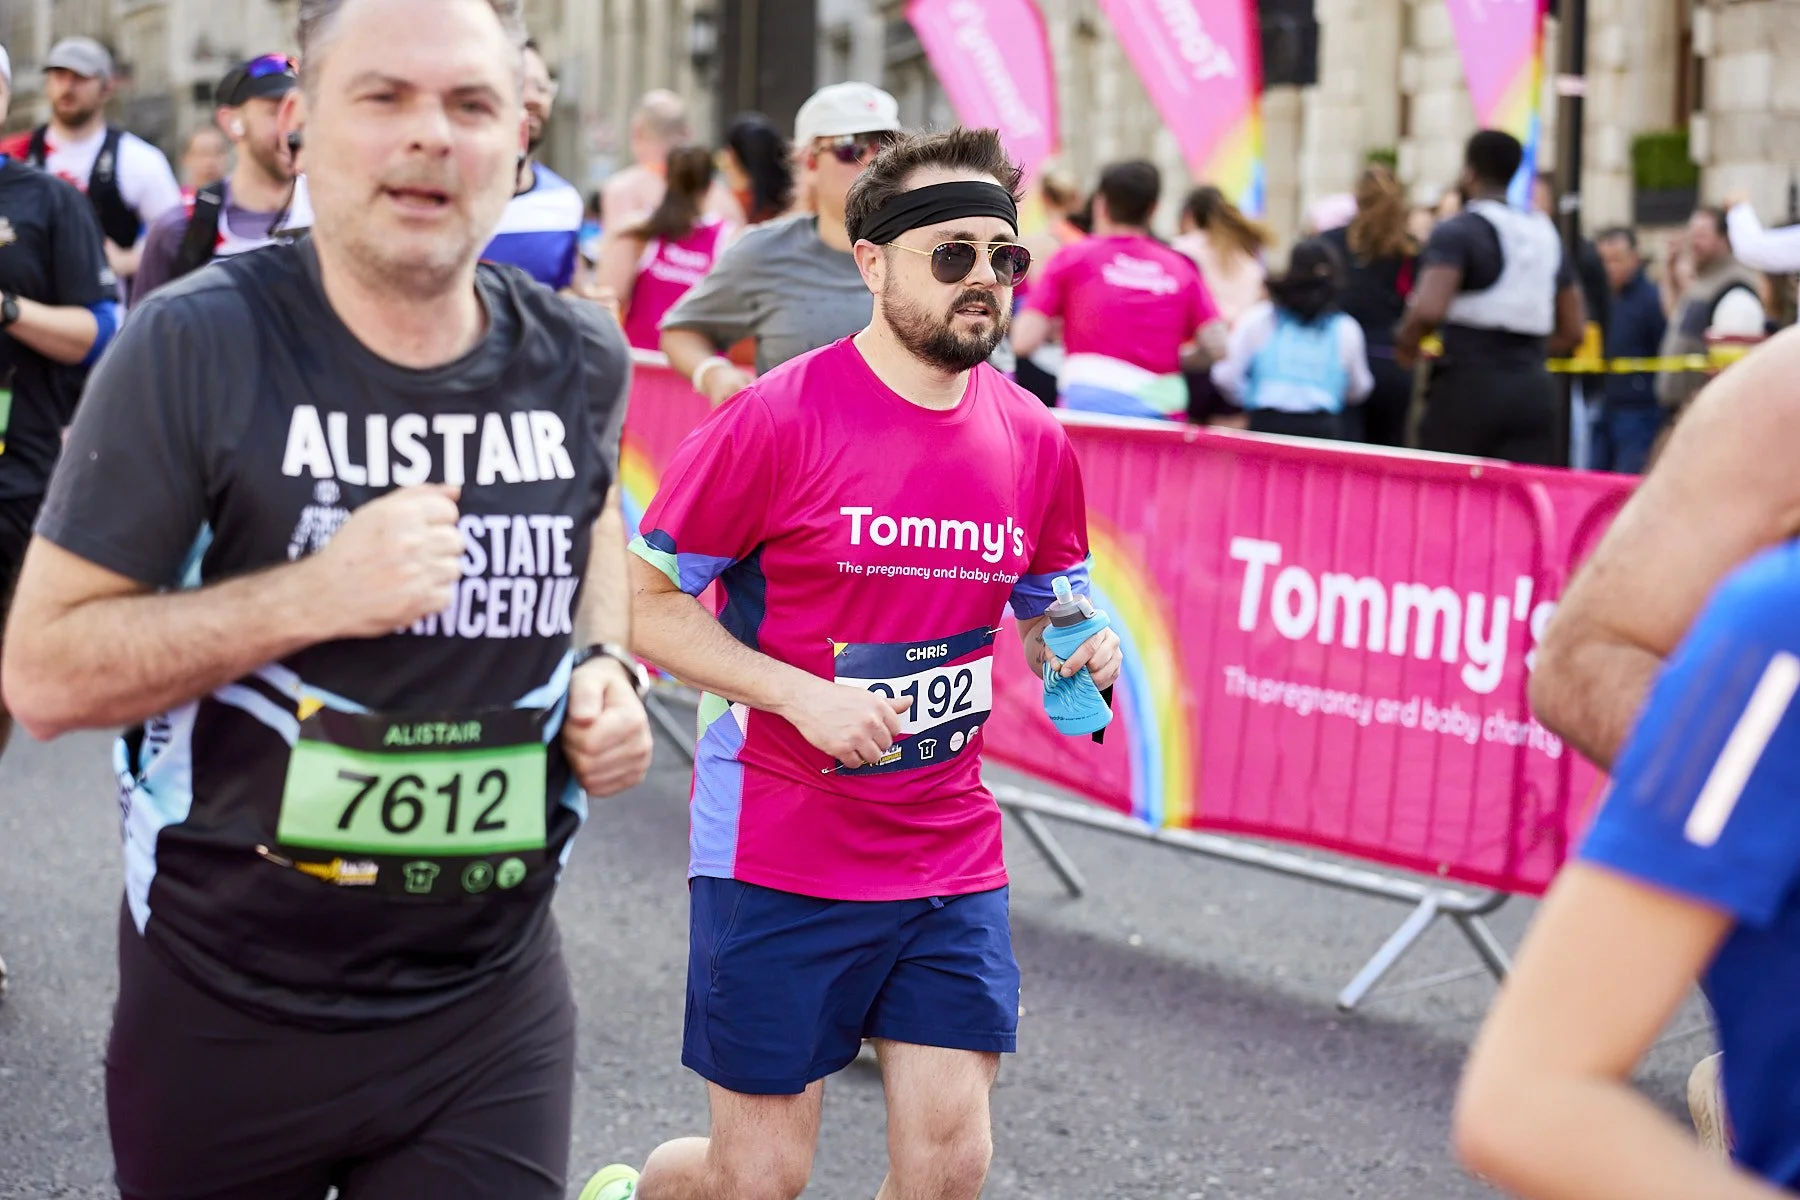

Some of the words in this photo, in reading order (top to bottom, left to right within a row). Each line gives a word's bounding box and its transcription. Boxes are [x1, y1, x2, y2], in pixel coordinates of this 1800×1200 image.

[281, 404, 576, 487] ALISTAIR
[458, 514, 574, 577] STATE
[839, 506, 1025, 564] Tommy's
[837, 561, 863, 574] The
[866, 564, 931, 580] pregnancy
[933, 566, 957, 579] and
[959, 568, 990, 584] baby
[905, 643, 948, 662] CHRIS
[384, 720, 483, 746] ALISTAIR
[1375, 694, 1421, 729] and
[1421, 701, 1482, 745] baby
[337, 767, 509, 835] 7612
